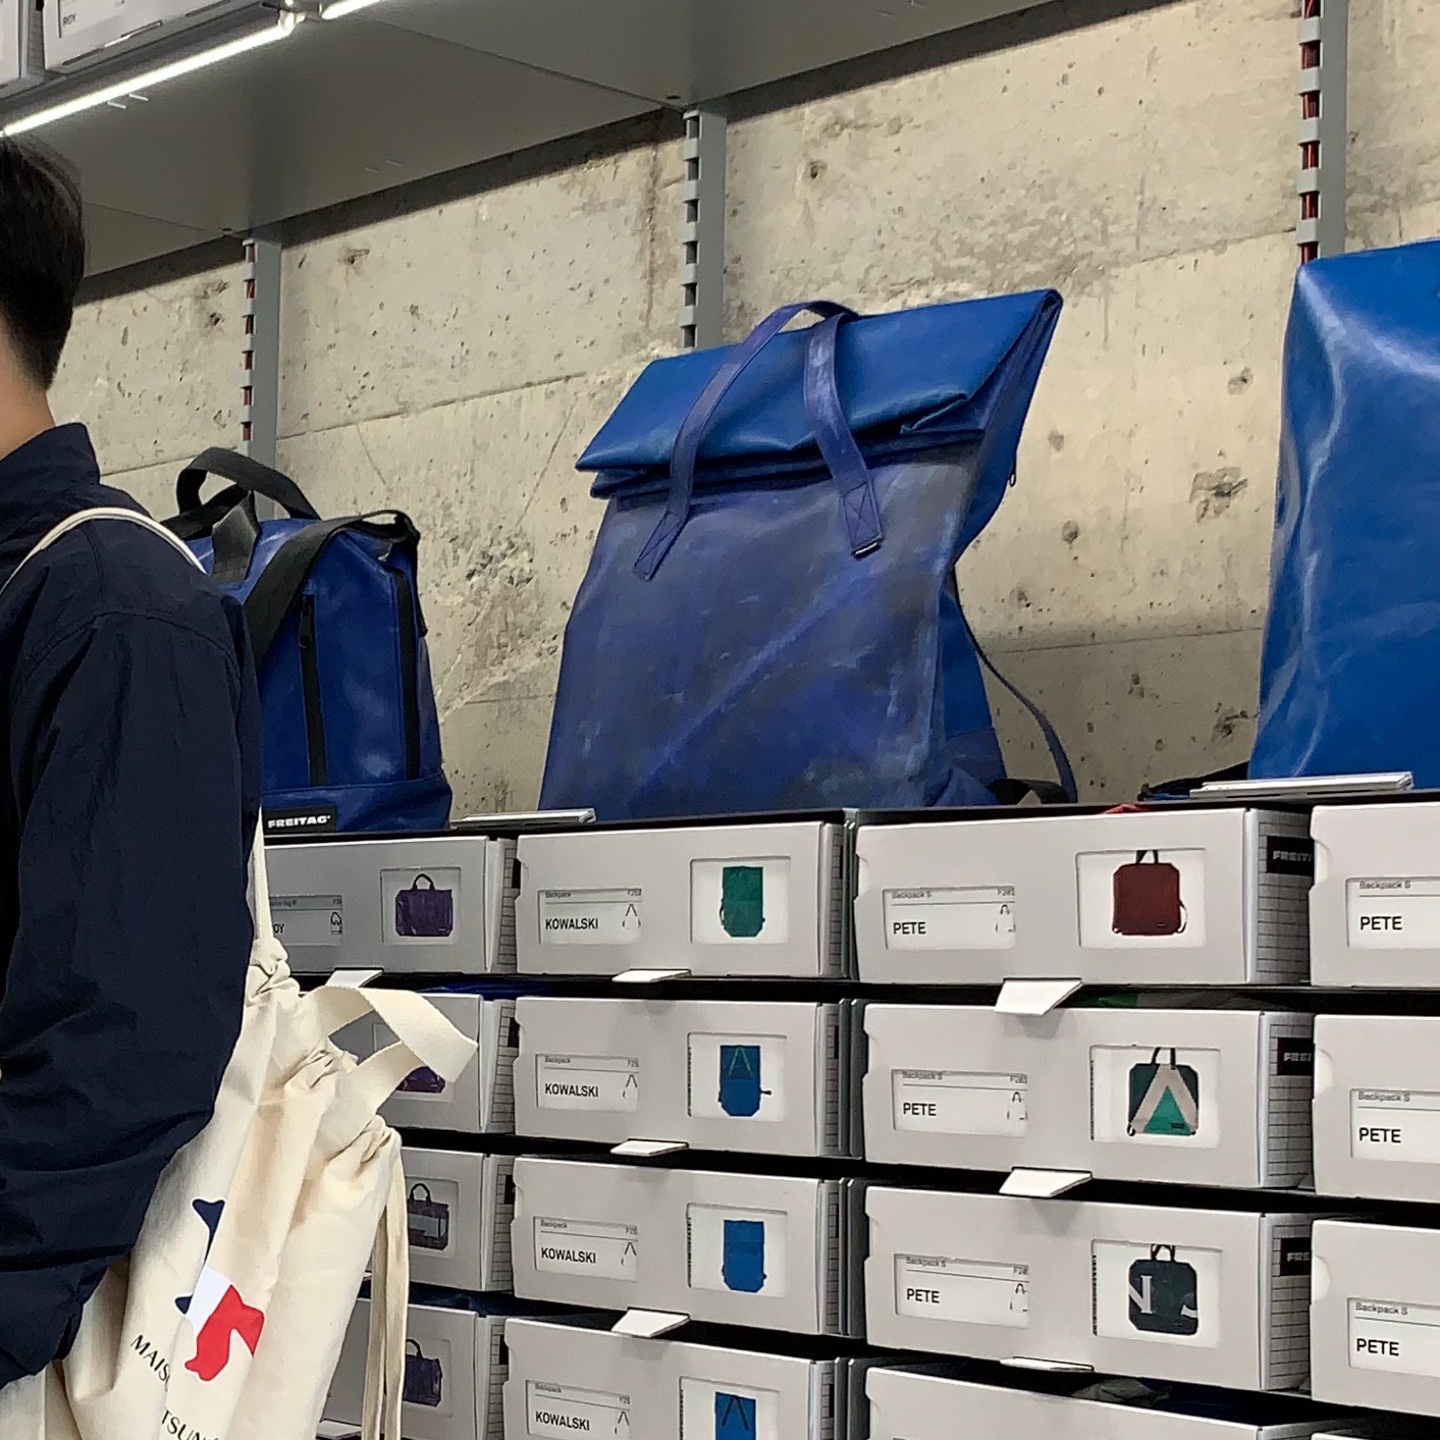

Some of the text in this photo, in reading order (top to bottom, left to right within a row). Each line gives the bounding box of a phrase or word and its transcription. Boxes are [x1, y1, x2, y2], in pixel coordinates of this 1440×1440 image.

[267, 815, 330, 829] FREITAG
[1360, 881, 1402, 890] Backpack
[272, 923, 285, 934] OY
[546, 918, 598, 929] KOWALSKI
[893, 921, 926, 934] PETE
[1360, 916, 1402, 930] PETE
[545, 1083, 598, 1097] KOWALSKI
[1358, 1091, 1401, 1102] Backpack
[903, 1102, 936, 1116] PETE
[1359, 1128, 1401, 1143] PETE
[541, 1247, 596, 1263] KOWALSKI
[906, 1288, 940, 1303] PETE
[1356, 1302, 1399, 1314] Backpack
[1356, 1338, 1399, 1356] PETE
[536, 1411, 590, 1430] KOWALSKI
